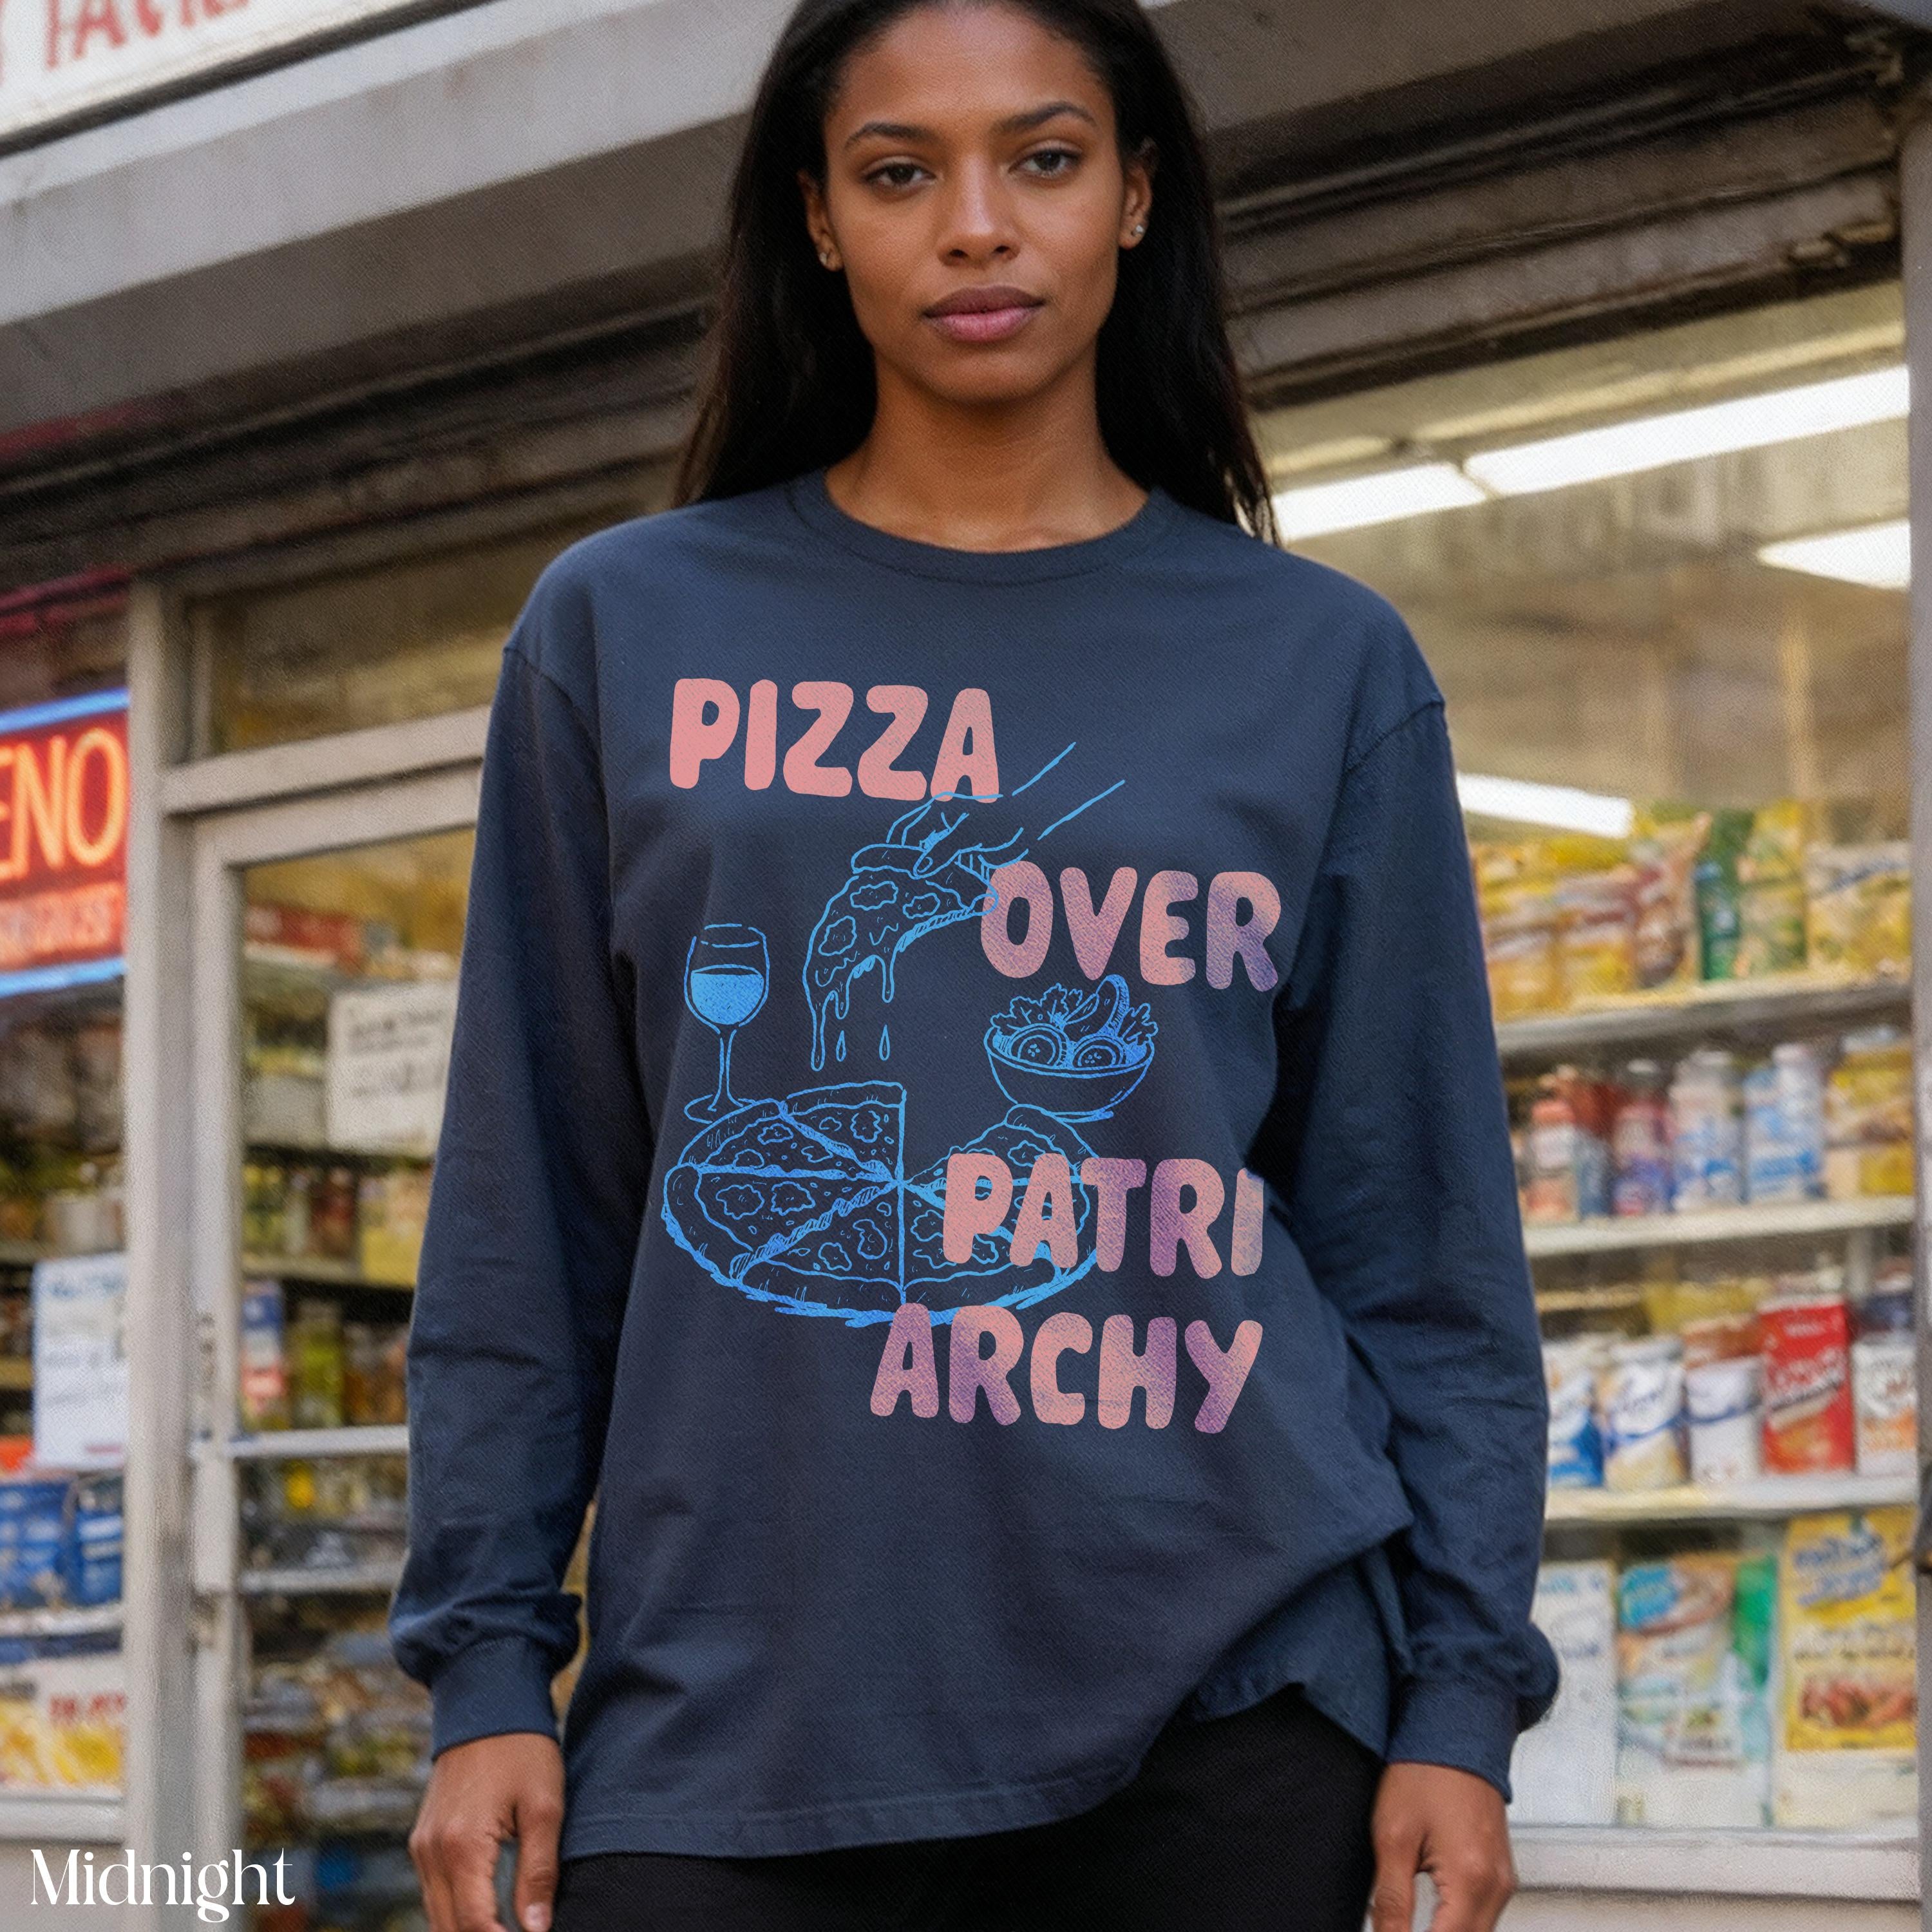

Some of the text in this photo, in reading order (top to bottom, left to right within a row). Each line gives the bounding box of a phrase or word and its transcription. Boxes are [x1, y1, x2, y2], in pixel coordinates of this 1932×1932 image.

[669, 677, 999, 802] PIZZA
[980, 860, 1282, 991] OVER
[942, 1152, 1264, 1279] PATRI
[870, 1303, 1264, 1434] ARCHY
